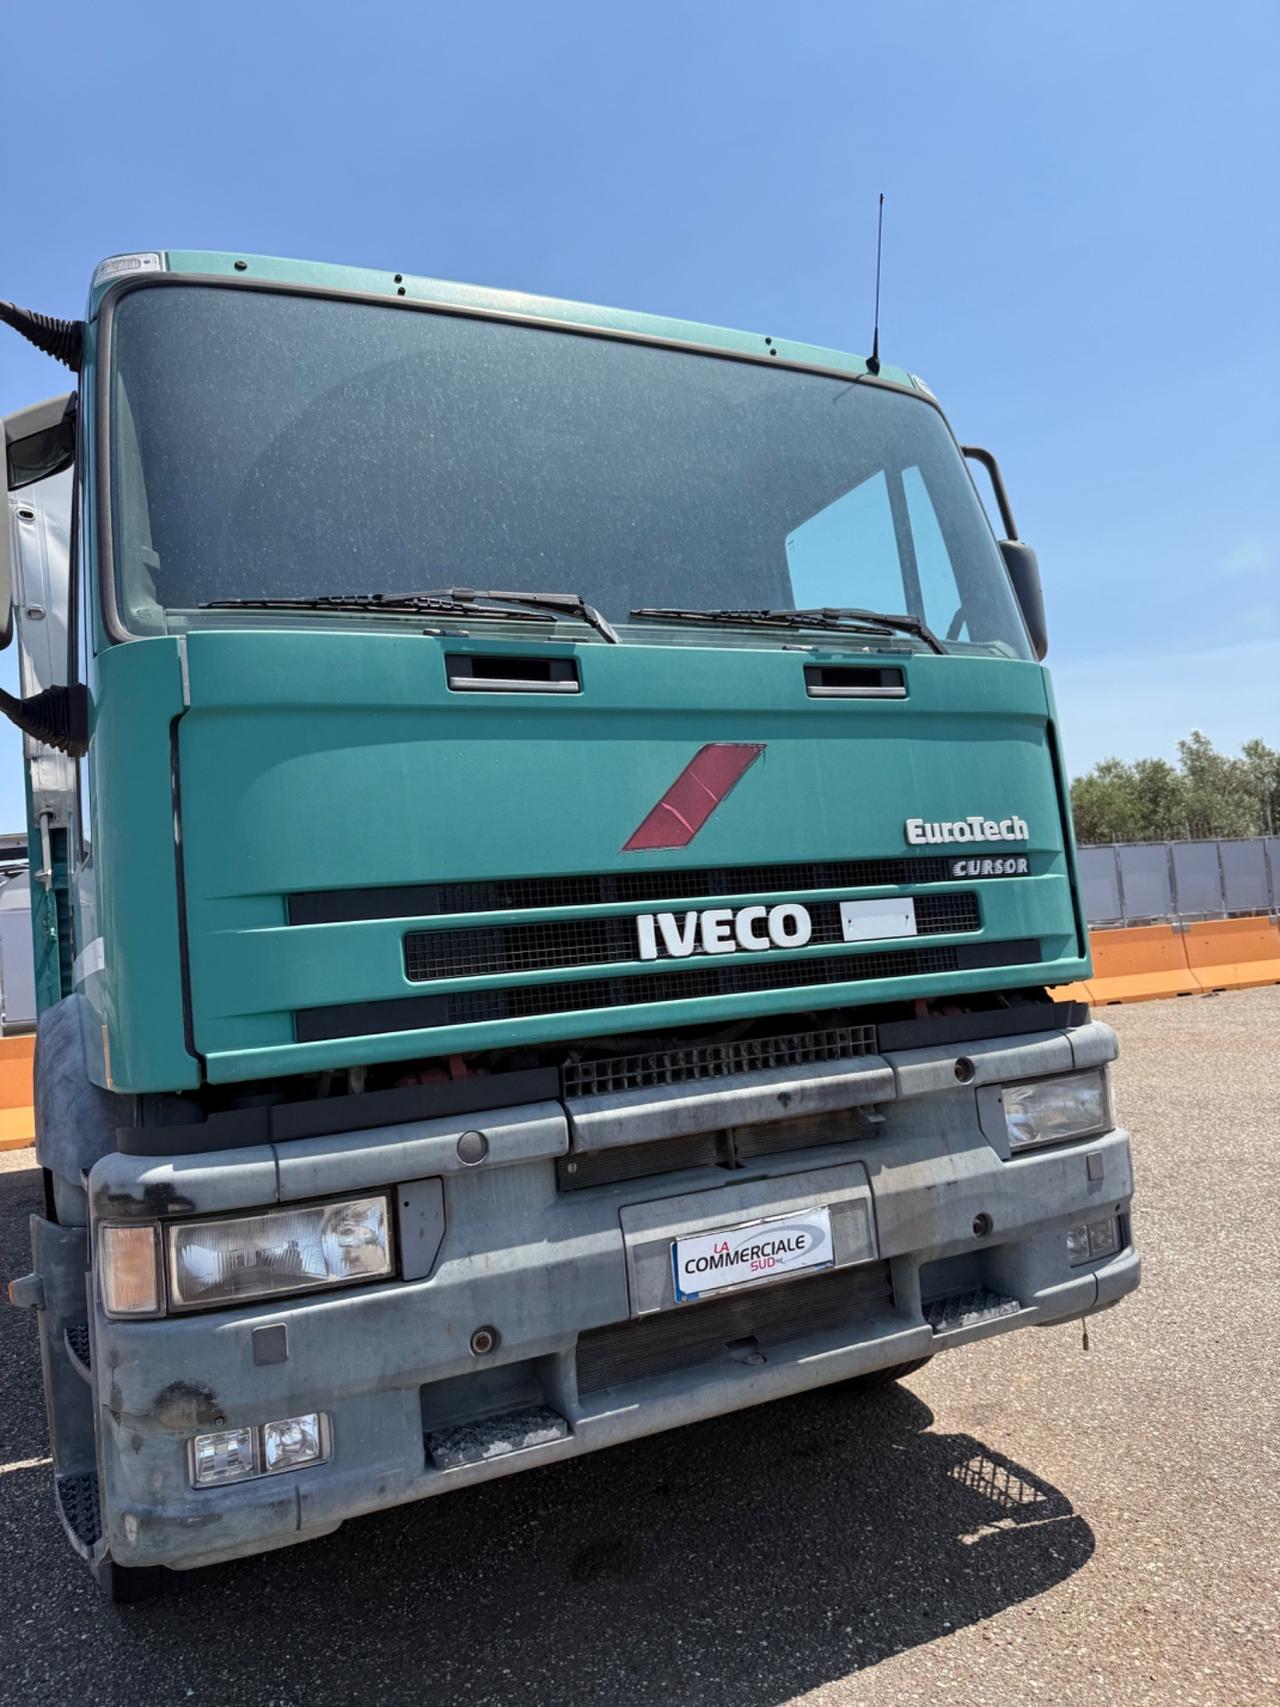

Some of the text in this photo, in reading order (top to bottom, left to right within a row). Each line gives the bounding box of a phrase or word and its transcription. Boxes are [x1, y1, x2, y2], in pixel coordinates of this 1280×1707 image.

[906, 815, 1029, 845] EuroTech
[952, 858, 1029, 877] CURSOR
[636, 903, 812, 960] IVECO
[685, 1234, 806, 1274] COMMERCIALE
[713, 1241, 730, 1254] LA
[751, 1256, 776, 1272] SUD
